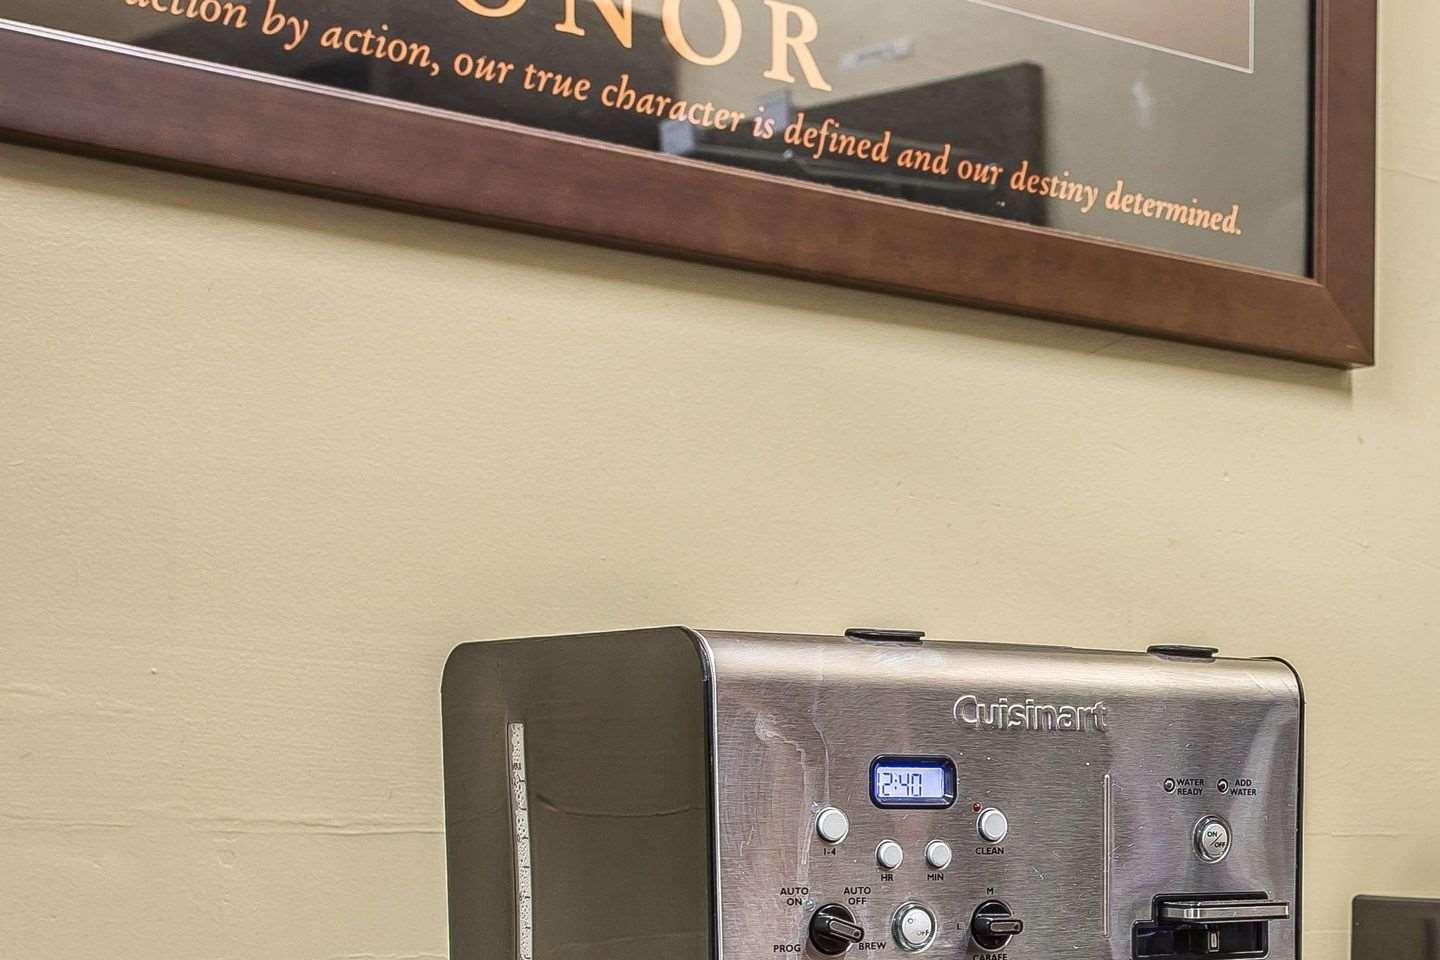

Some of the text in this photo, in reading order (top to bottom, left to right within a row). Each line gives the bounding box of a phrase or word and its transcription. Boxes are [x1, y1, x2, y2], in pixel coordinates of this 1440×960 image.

[262, 0, 309, 50] by
[320, 24, 440, 77] action,
[453, 53, 515, 84] our
[524, 64, 591, 101] true
[601, 74, 746, 132] character
[752, 106, 775, 140] is
[783, 112, 890, 161] defined
[897, 144, 951, 176] and
[957, 158, 1004, 187] our
[1010, 160, 1099, 213] destiny
[1105, 181, 1243, 236] determined.
[953, 694, 1109, 731] Cuisinart
[1176, 779, 1204, 787] WATER
[1234, 779, 1252, 787] ADD
[1177, 788, 1203, 796] READY
[1230, 788, 1257, 796] WATER
[975, 847, 1005, 855] CLEAN
[880, 874, 894, 882] HR
[927, 873, 945, 881] MIN
[780, 887, 809, 896] AUTO
[843, 887, 872, 896] AUTO
[786, 898, 803, 906] ON
[848, 897, 868, 905] OFF
[773, 944, 801, 953] PROG
[858, 942, 887, 951] BREW
